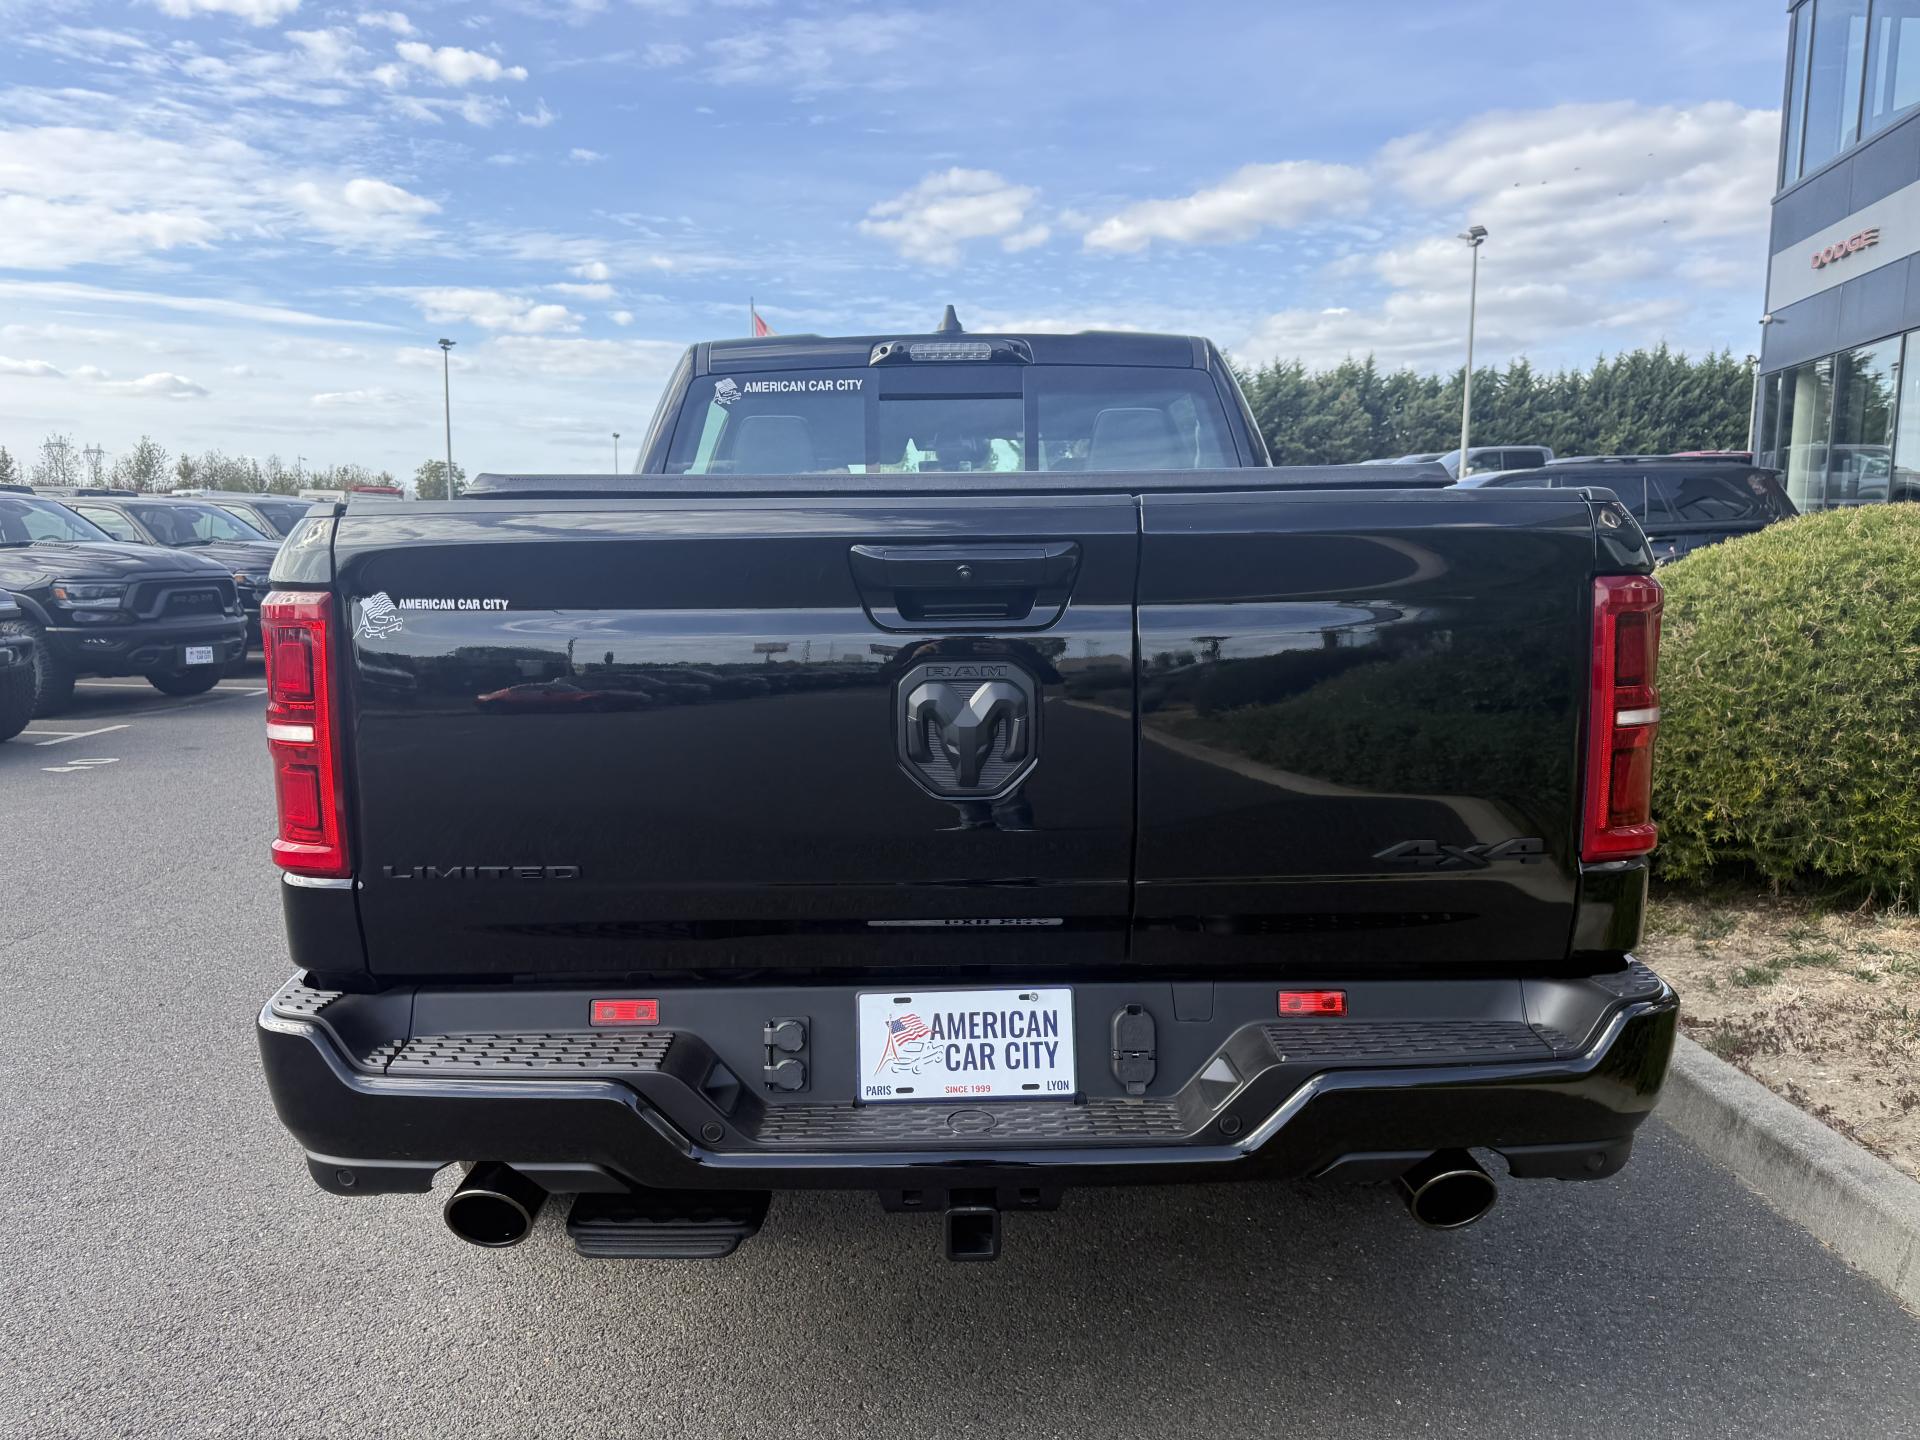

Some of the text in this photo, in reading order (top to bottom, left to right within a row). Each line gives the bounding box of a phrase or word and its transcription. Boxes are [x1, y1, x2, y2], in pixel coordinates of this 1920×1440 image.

[1809, 228, 1879, 270] DODGE
[744, 379, 863, 393] AMERICAN CAR CITY
[398, 599, 509, 611] AMERICAN CAR CITY
[926, 666, 1008, 678] RAM
[383, 865, 582, 880] LIMITED
[929, 1010, 1059, 1041] AMERICAN
[945, 1041, 1059, 1072] CAR CITY
[866, 1085, 892, 1096] PARIS
[945, 1084, 991, 1094] SINCE 1999
[1047, 1080, 1070, 1091] LYON
